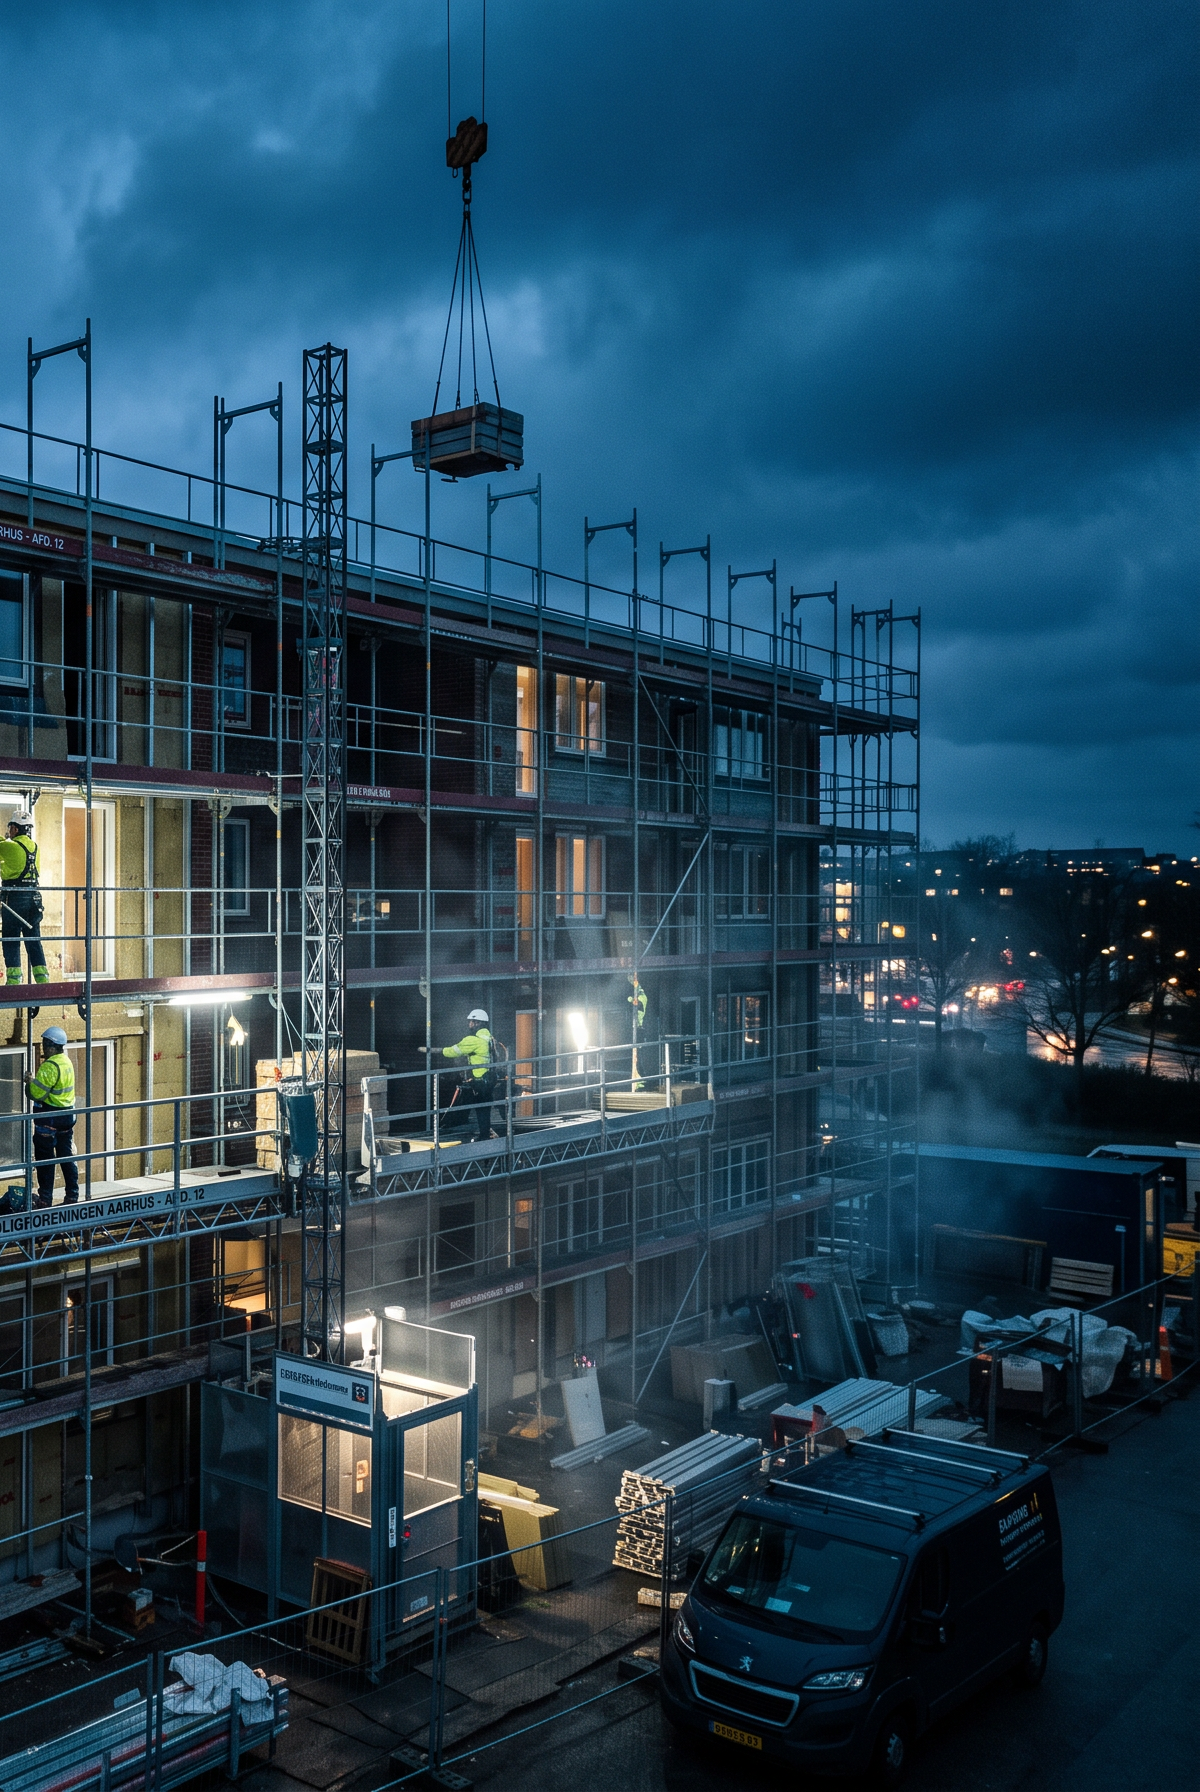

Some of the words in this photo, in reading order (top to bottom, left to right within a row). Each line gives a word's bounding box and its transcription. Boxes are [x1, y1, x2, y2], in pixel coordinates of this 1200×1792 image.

[54, 538, 64, 550] 12
[107, 1196, 155, 1215] AARHUS
[194, 1188, 205, 1200] 12
